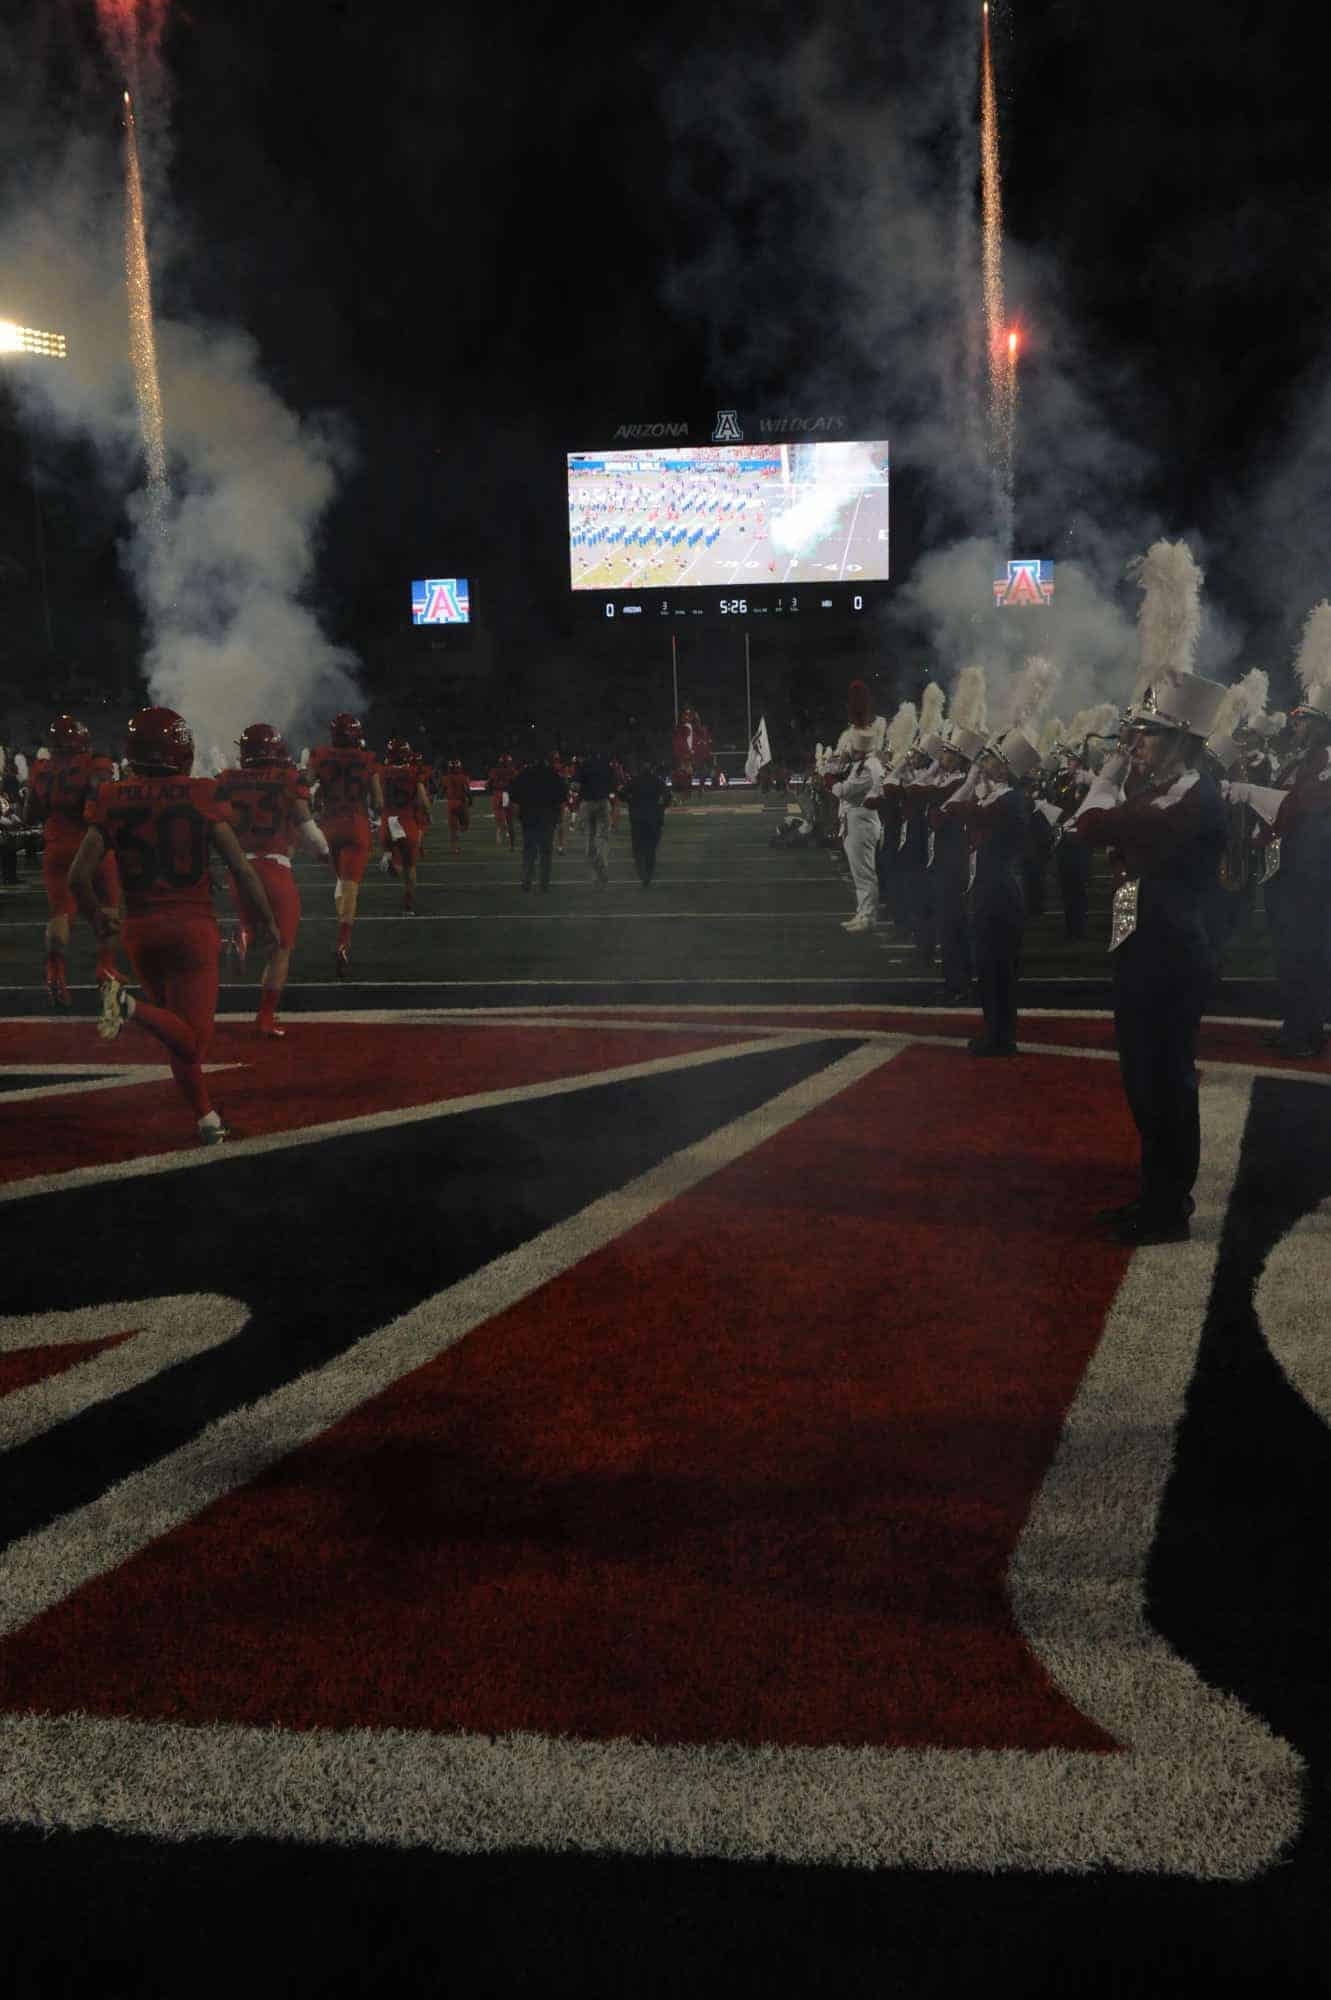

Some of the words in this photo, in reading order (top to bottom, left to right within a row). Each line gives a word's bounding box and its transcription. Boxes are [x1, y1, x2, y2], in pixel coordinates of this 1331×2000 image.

[613, 421, 689, 440] ARIZONA
[711, 409, 743, 441] A
[759, 415, 848, 434] WILDCATS
[418, 579, 468, 624] A
[996, 561, 1050, 605] A
[719, 600, 748, 614] 5:26
